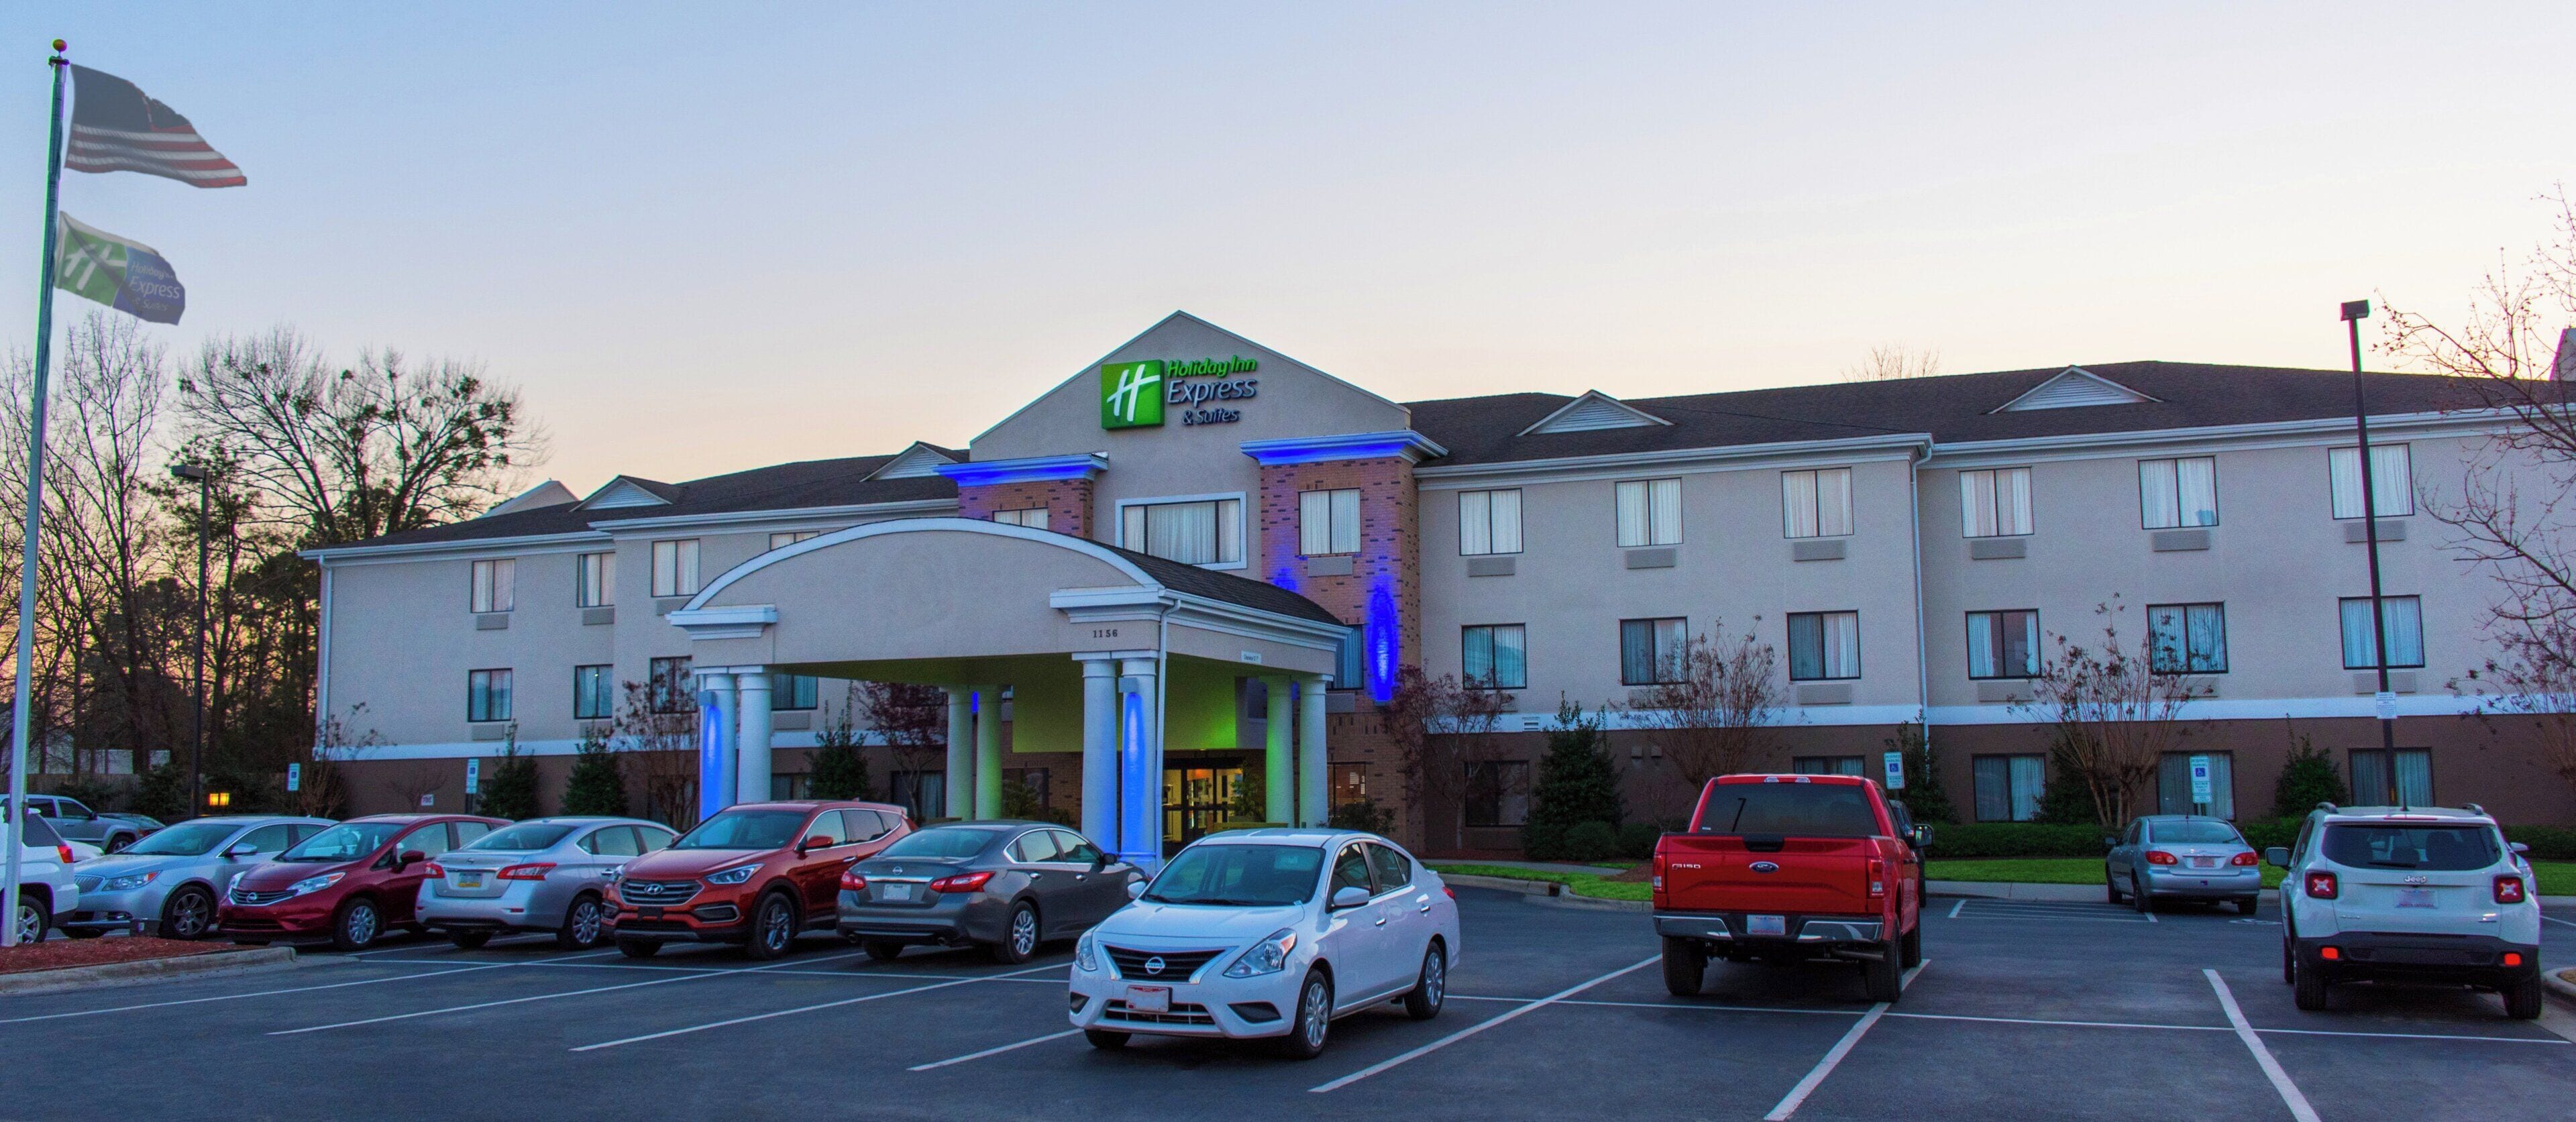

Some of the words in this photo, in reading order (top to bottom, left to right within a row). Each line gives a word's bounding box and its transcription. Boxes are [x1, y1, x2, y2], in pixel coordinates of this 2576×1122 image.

[129, 276, 180, 298] Express
[1167, 357, 1230, 378] Holiday
[1230, 355, 1257, 372] Inn
[1167, 378, 1257, 408] Express
[1182, 410, 1194, 425] &
[1197, 407, 1240, 424] Suites
[1093, 629, 1118, 638] 1156
[2404, 875, 2427, 883] Jeep
